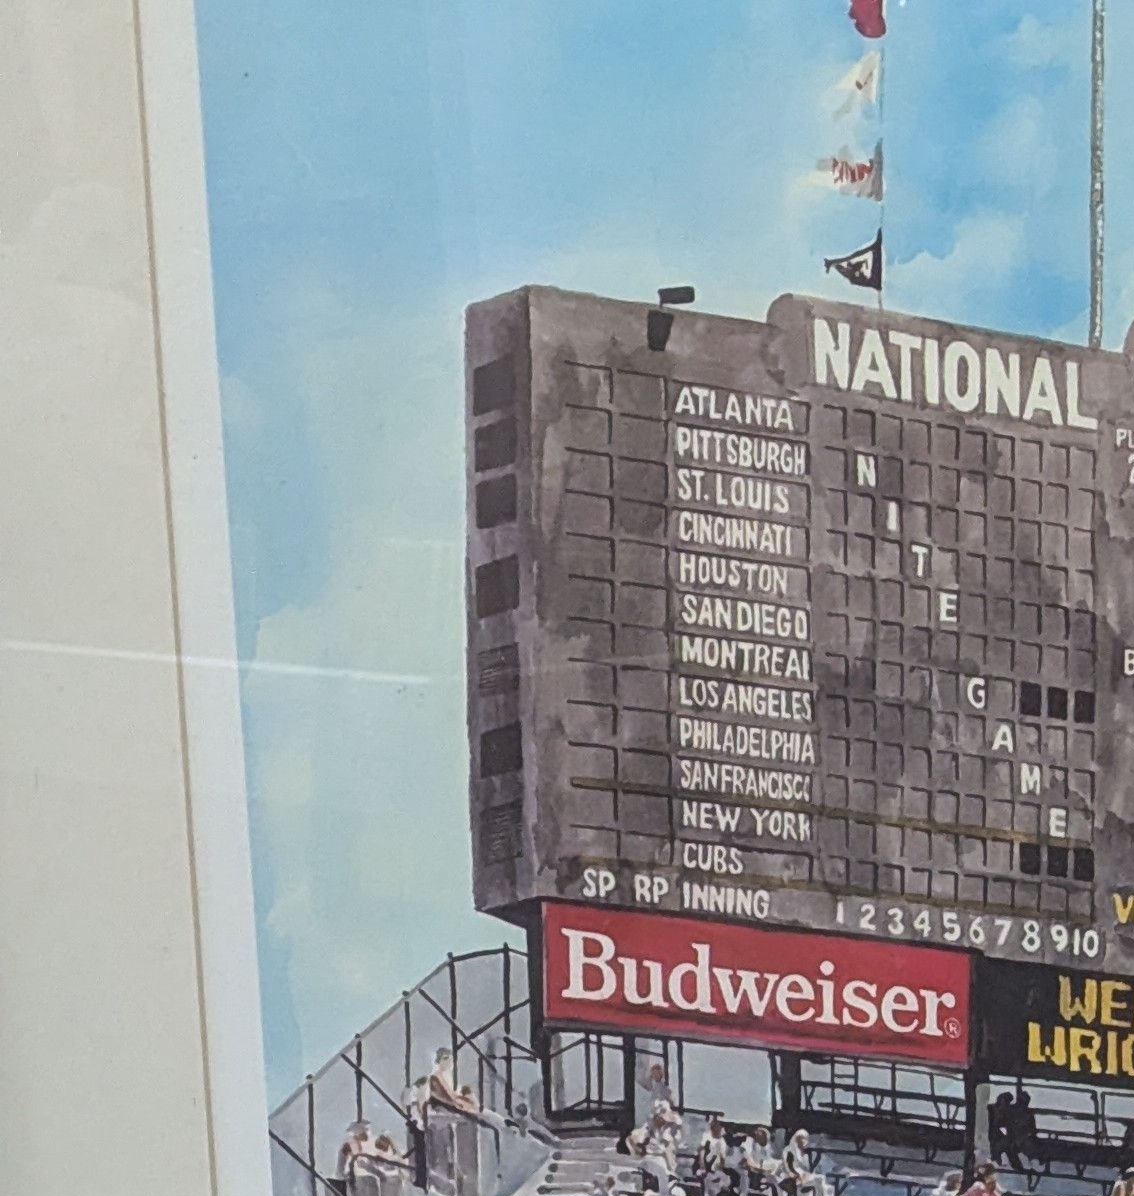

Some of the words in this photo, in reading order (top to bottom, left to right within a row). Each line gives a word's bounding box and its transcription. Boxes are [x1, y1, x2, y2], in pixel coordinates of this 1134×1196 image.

[813, 319, 1098, 430] NATIONAL
[675, 386, 794, 431] ATLANTA
[676, 427, 807, 475] PITTSBURGH
[677, 469, 710, 501] ST.
[716, 473, 790, 514] LOUIS
[679, 511, 792, 556] CINCINNATI
[679, 553, 788, 598] HOUSTON
[682, 594, 732, 629] SAN
[737, 601, 808, 639] DIEGO
[679, 677, 719, 708] LOS
[722, 683, 812, 721] ANGELES
[679, 718, 815, 765] PHILADELPHIA
[682, 800, 741, 832] NEW
[750, 808, 812, 841] YORK
[684, 842, 743, 874] CUBS
[583, 868, 616, 897] SP
[635, 875, 669, 904] RP
[683, 881, 769, 919] INNING
